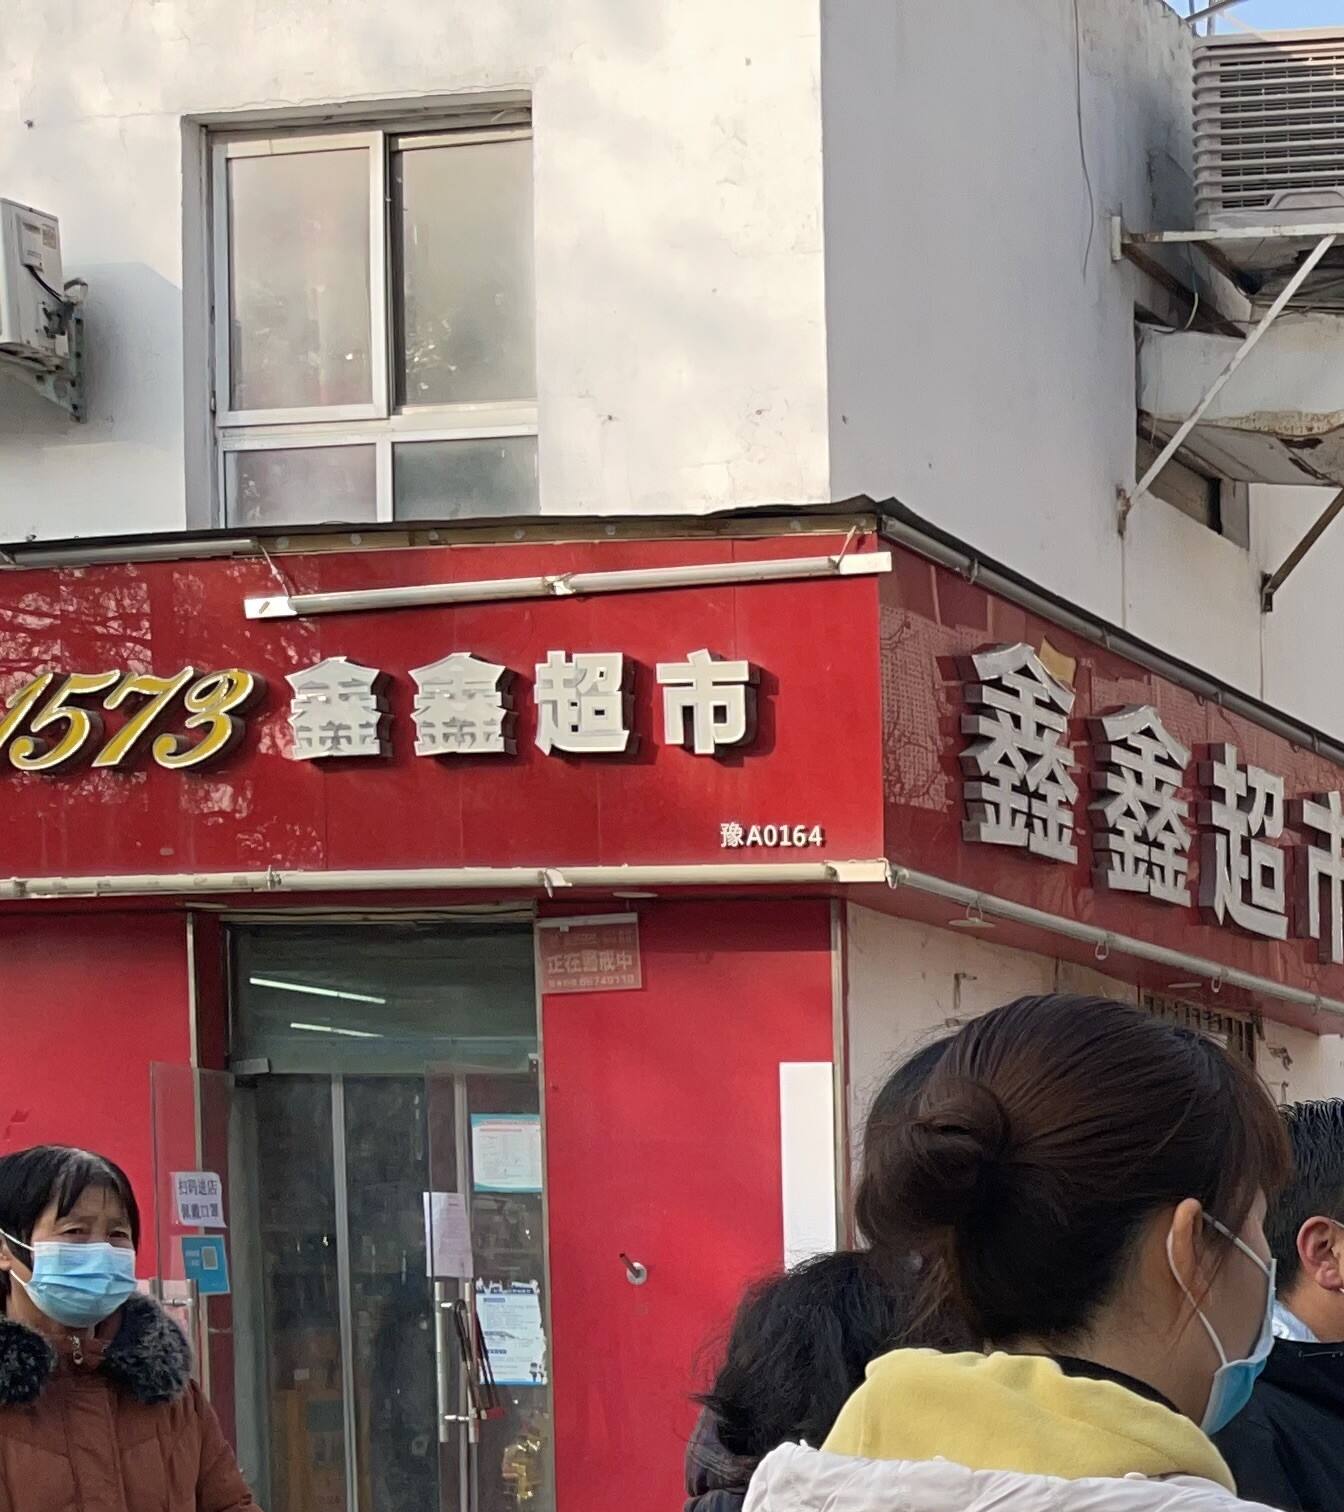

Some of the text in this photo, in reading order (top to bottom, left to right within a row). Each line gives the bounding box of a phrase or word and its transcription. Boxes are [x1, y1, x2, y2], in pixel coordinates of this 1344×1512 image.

[0, 649, 753, 770] 1573 鑫鑫超市
[720, 822, 823, 847] 豫A0164
